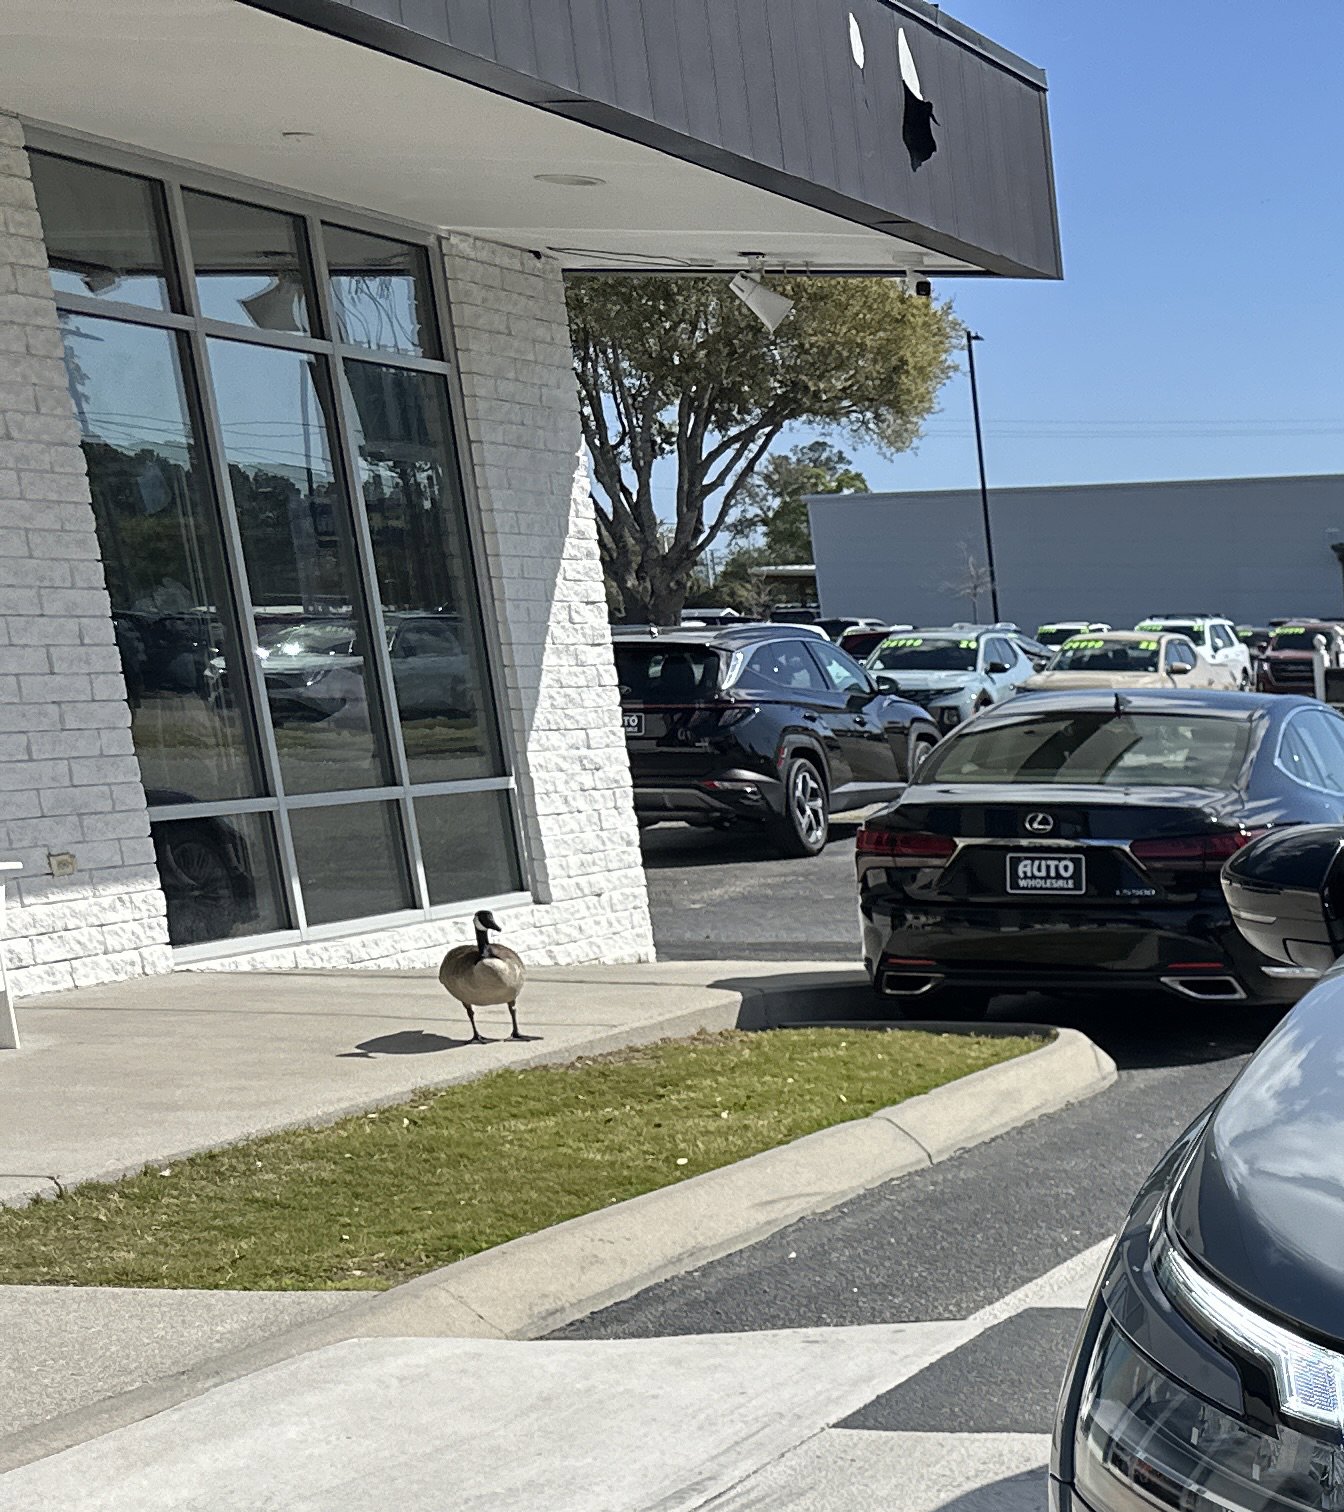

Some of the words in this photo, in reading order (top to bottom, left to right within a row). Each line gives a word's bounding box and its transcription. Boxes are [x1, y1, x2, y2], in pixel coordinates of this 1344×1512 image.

[623, 714, 638, 726] TO
[1018, 859, 1074, 878] AUTO
[1017, 879, 1074, 888] WHOLESALE
